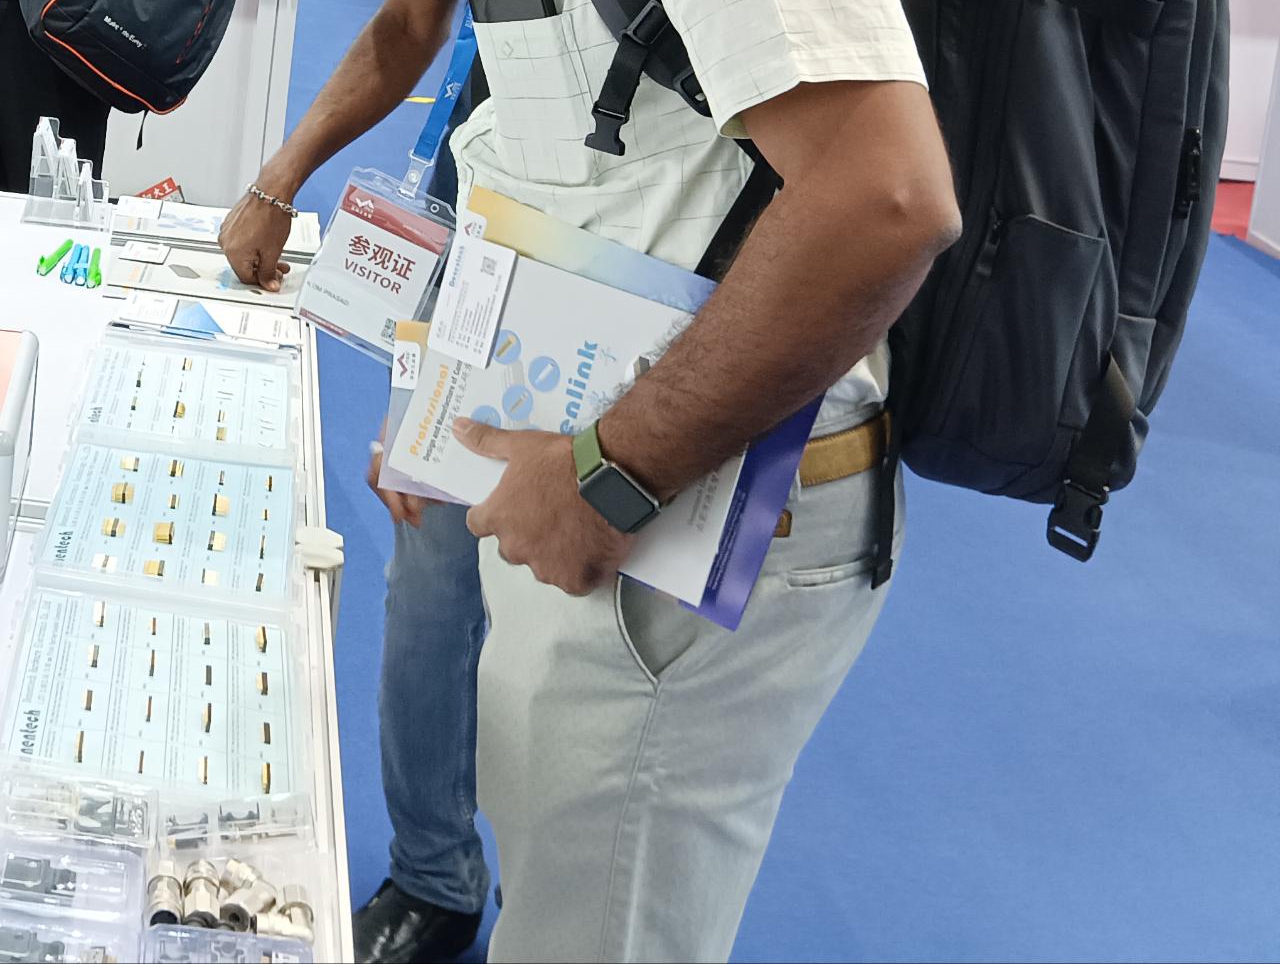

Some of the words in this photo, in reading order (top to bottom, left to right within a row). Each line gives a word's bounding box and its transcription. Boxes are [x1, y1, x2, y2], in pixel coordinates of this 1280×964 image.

[344, 258, 403, 295] VISITOR
[348, 234, 417, 281] 参观证
[409, 363, 450, 456] Professional
[20, 709, 42, 756] nentech
